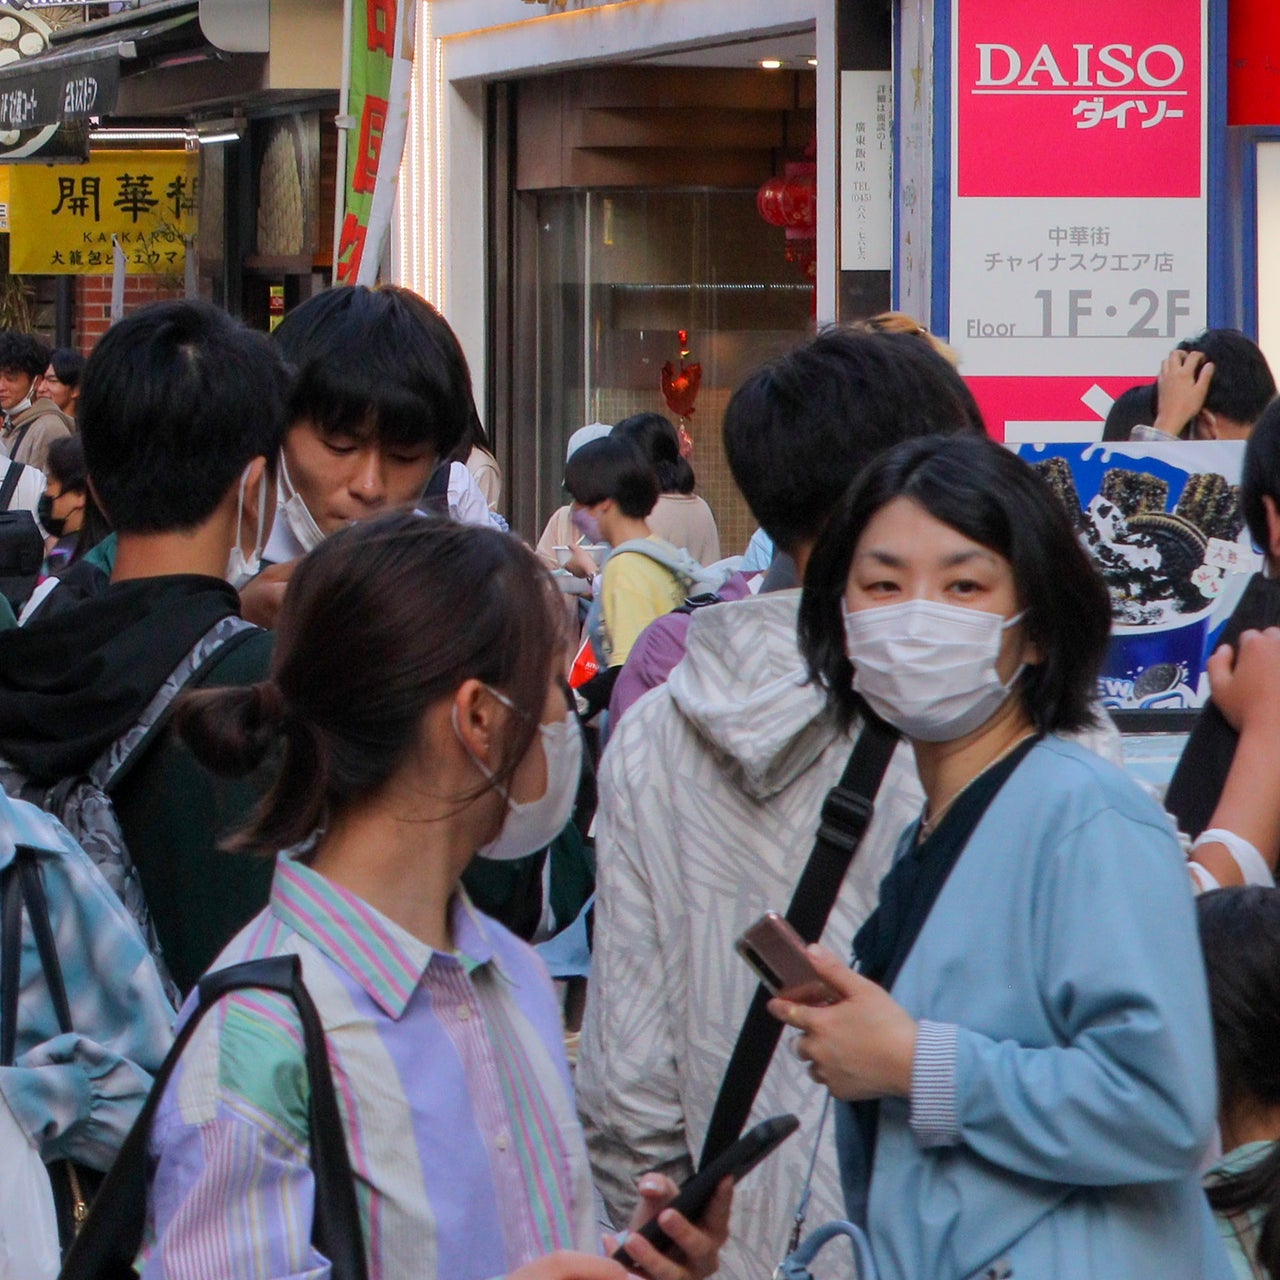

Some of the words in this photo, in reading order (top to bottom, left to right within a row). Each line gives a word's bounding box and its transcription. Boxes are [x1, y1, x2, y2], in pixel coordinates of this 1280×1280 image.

[975, 43, 1184, 87] DAISO
[1072, 97, 1183, 129] ダイソー
[854, 122, 867, 172] 廣東飯店
[853, 182, 870, 192] TEL
[851, 194, 872, 203] (045)
[1048, 226, 1110, 246] 中華街
[984, 252, 1174, 273] チャイナスクエア店
[1034, 288, 1190, 337] 1F・2F
[967, 319, 1016, 337] Floor
